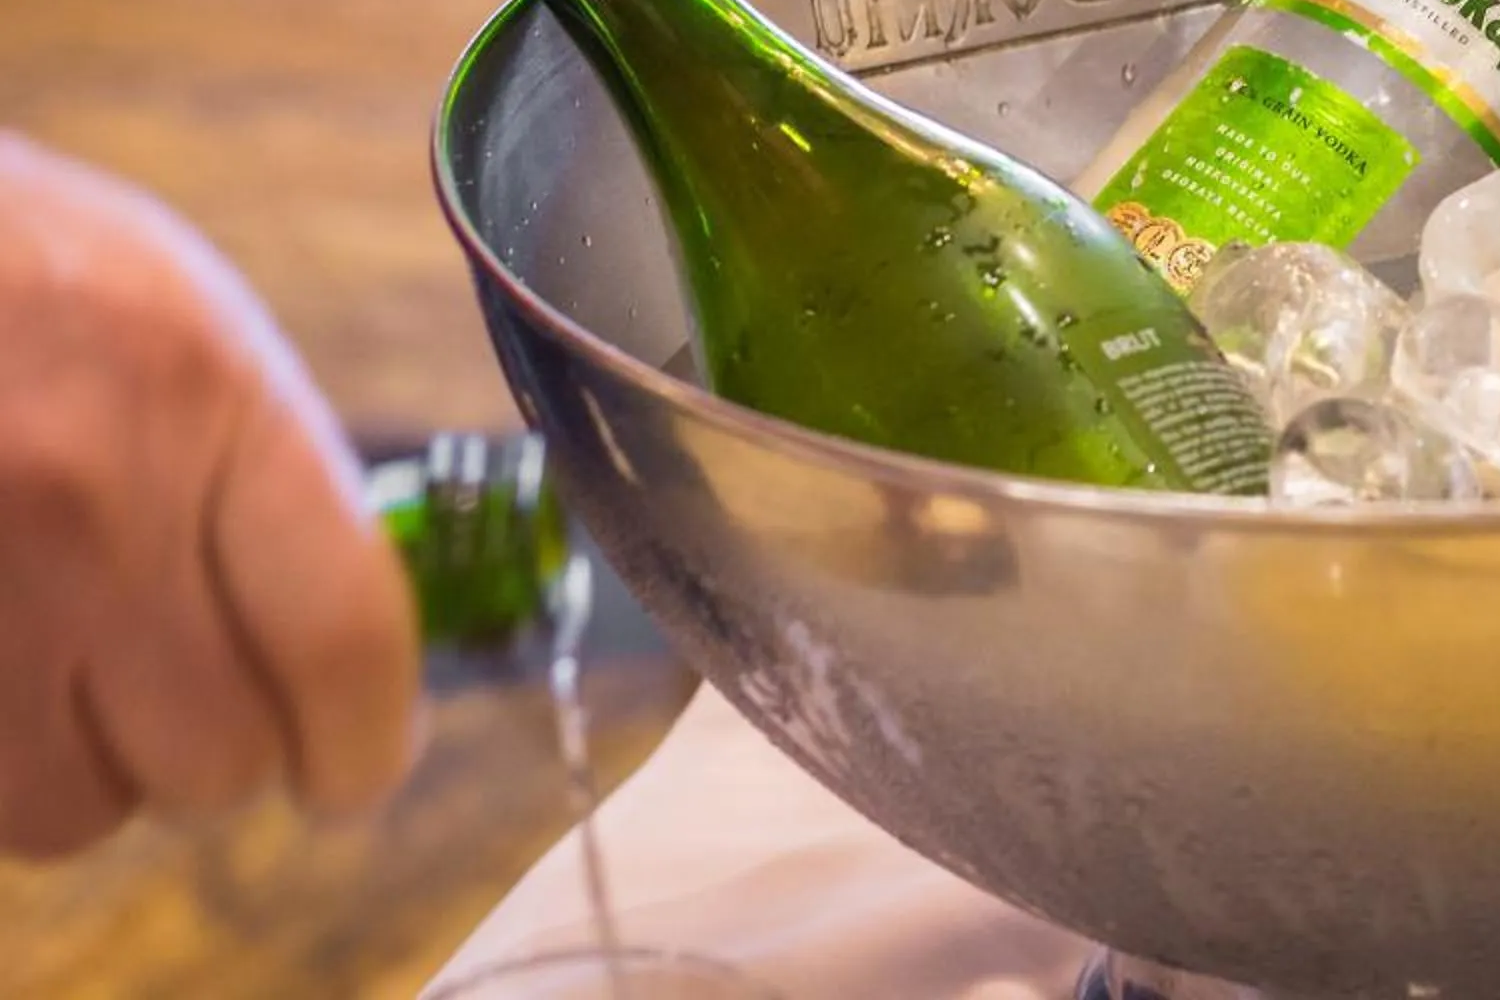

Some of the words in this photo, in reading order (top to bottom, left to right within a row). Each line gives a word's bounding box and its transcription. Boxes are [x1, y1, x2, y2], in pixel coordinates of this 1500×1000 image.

[1216, 122, 1255, 149] MADE
[1259, 144, 1278, 162] TO
[1262, 94, 1311, 131] GRAIN
[1316, 125, 1368, 177] VODKA
[1214, 145, 1281, 194] ORIGINAL
